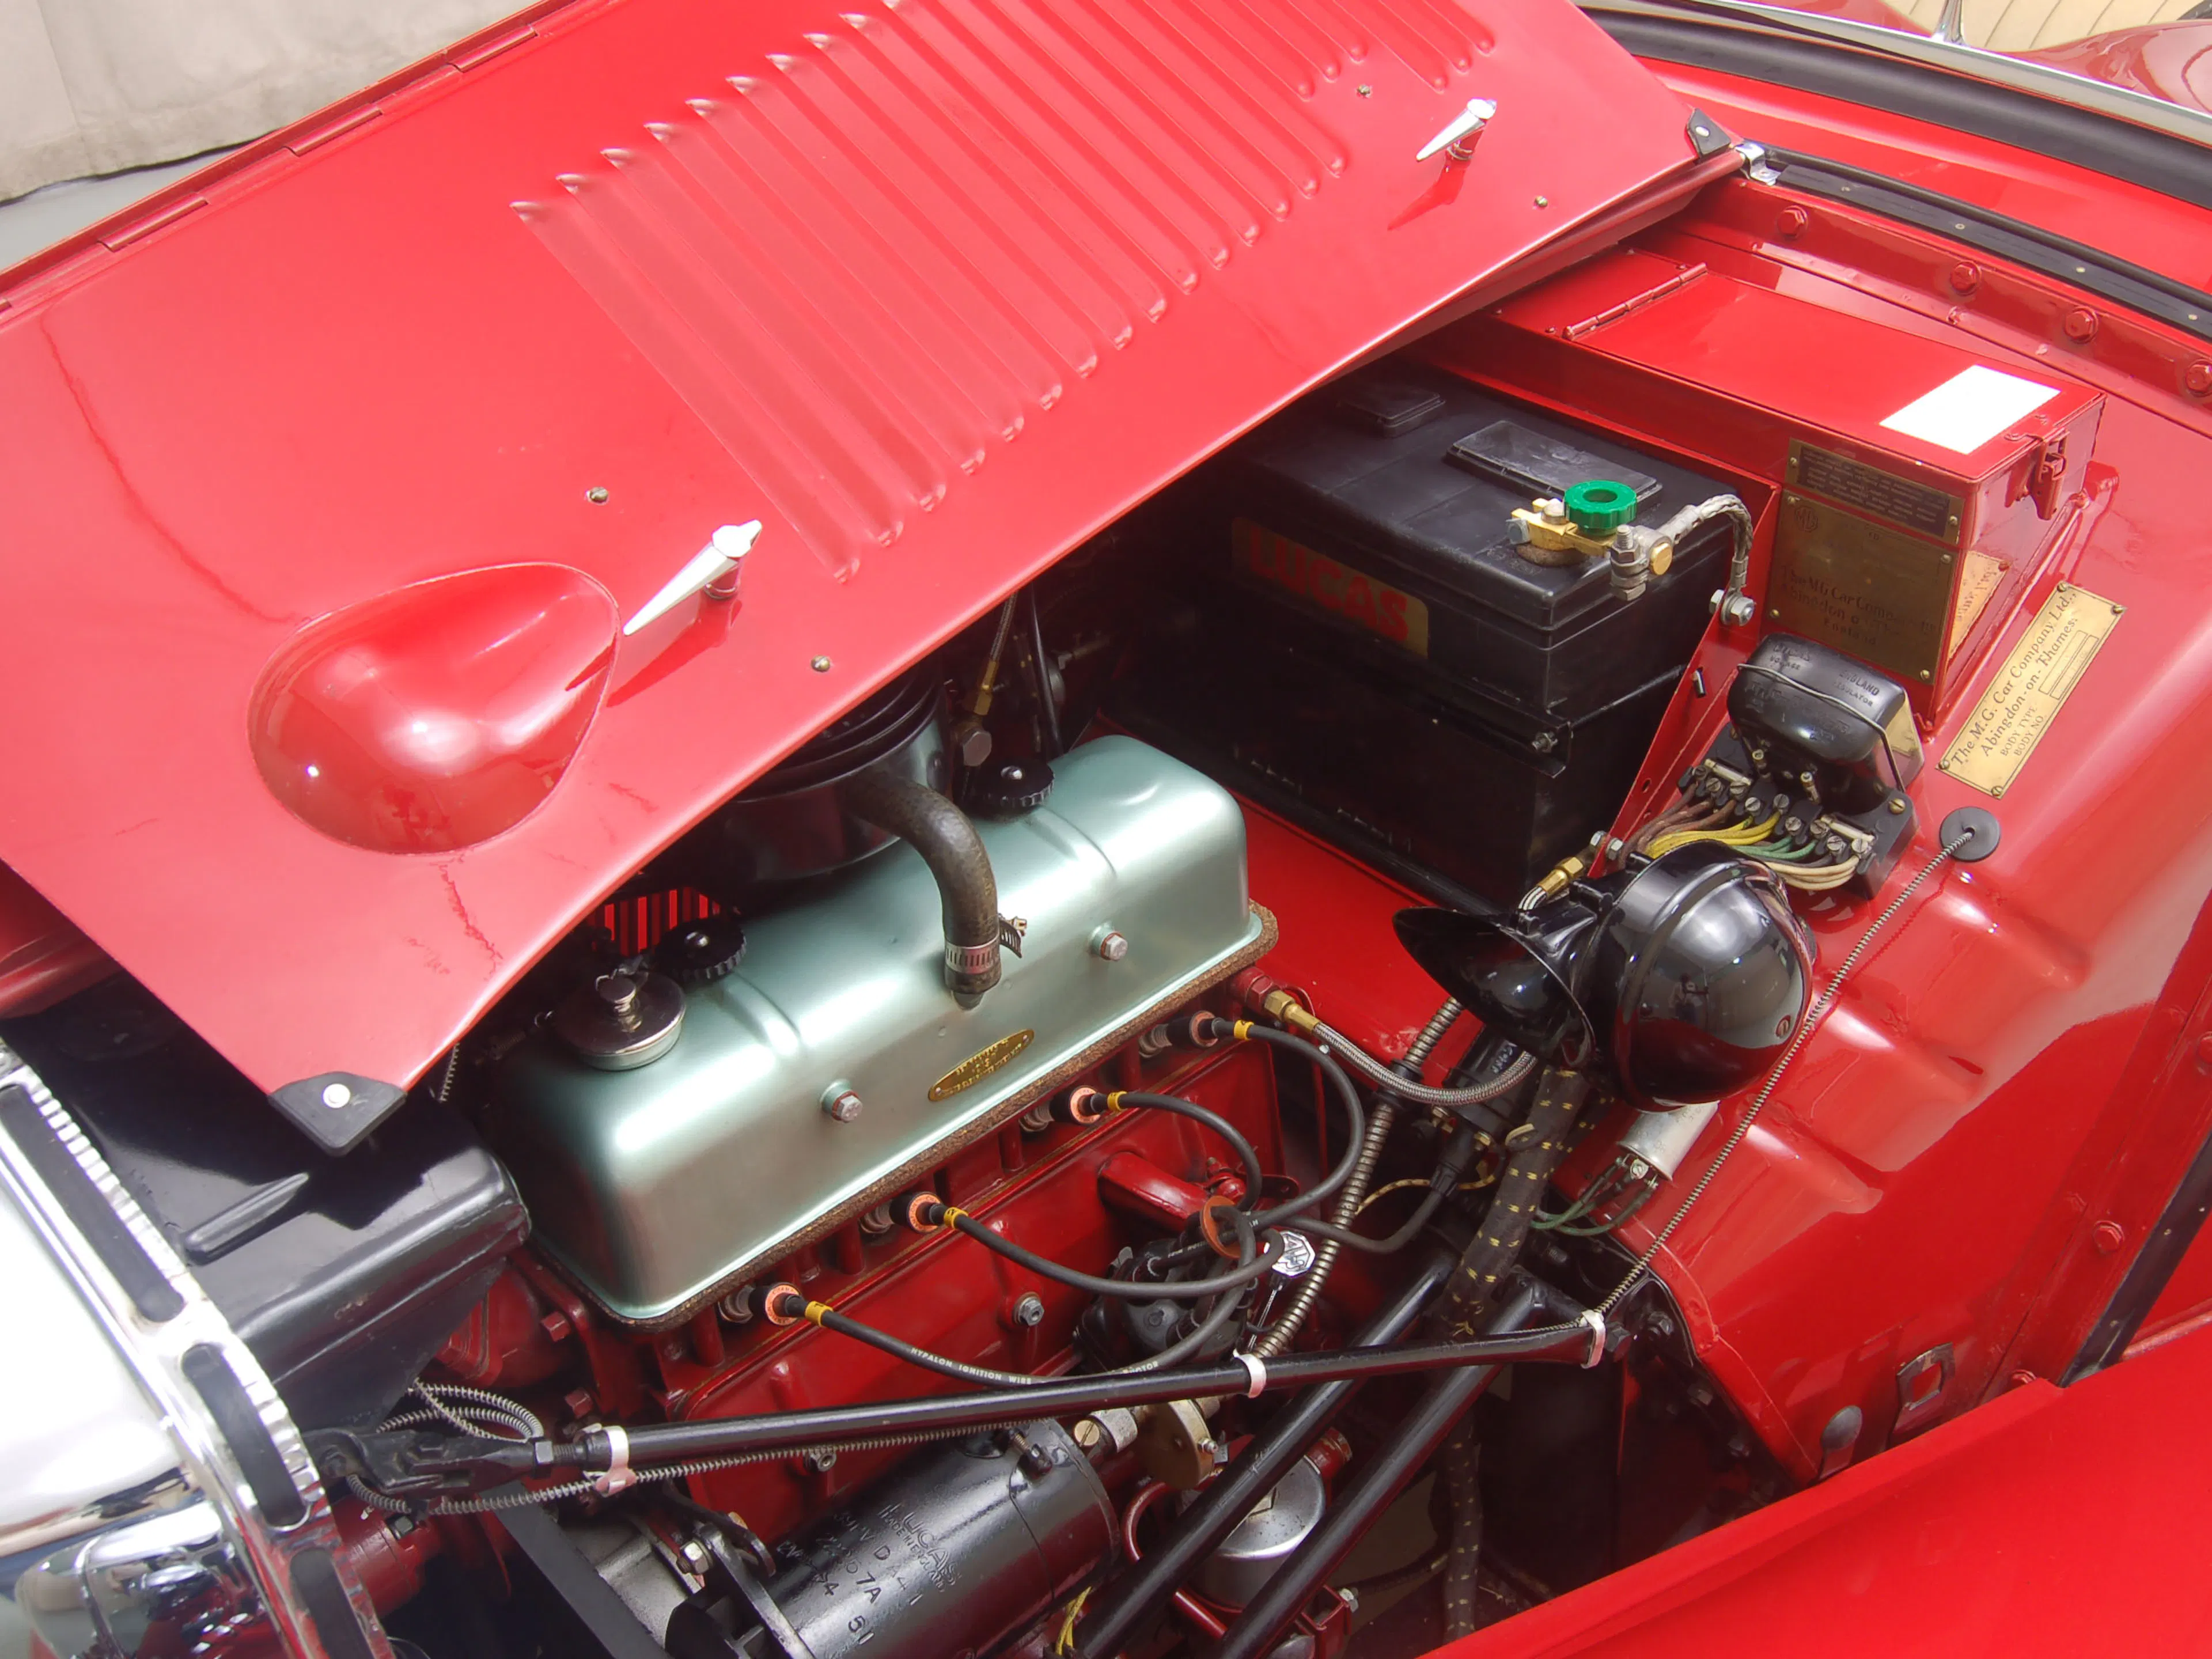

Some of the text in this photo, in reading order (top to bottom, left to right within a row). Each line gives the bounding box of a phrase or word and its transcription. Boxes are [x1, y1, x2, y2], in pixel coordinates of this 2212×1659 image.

[1248, 525, 1408, 643] LUCAS
[1831, 586, 1855, 605] Car
[1951, 741, 1975, 765] The
[1969, 709, 1997, 740] M.G.
[1993, 680, 2014, 704] Car
[2010, 622, 2055, 678] Company
[2000, 706, 2037, 756] BODY TYPE
[2013, 732, 2033, 756] BODY
[911, 1347, 953, 1368] HYPALON
[958, 1364, 1002, 1381] IGNITION
[877, 1503, 957, 1587] LUCAS
